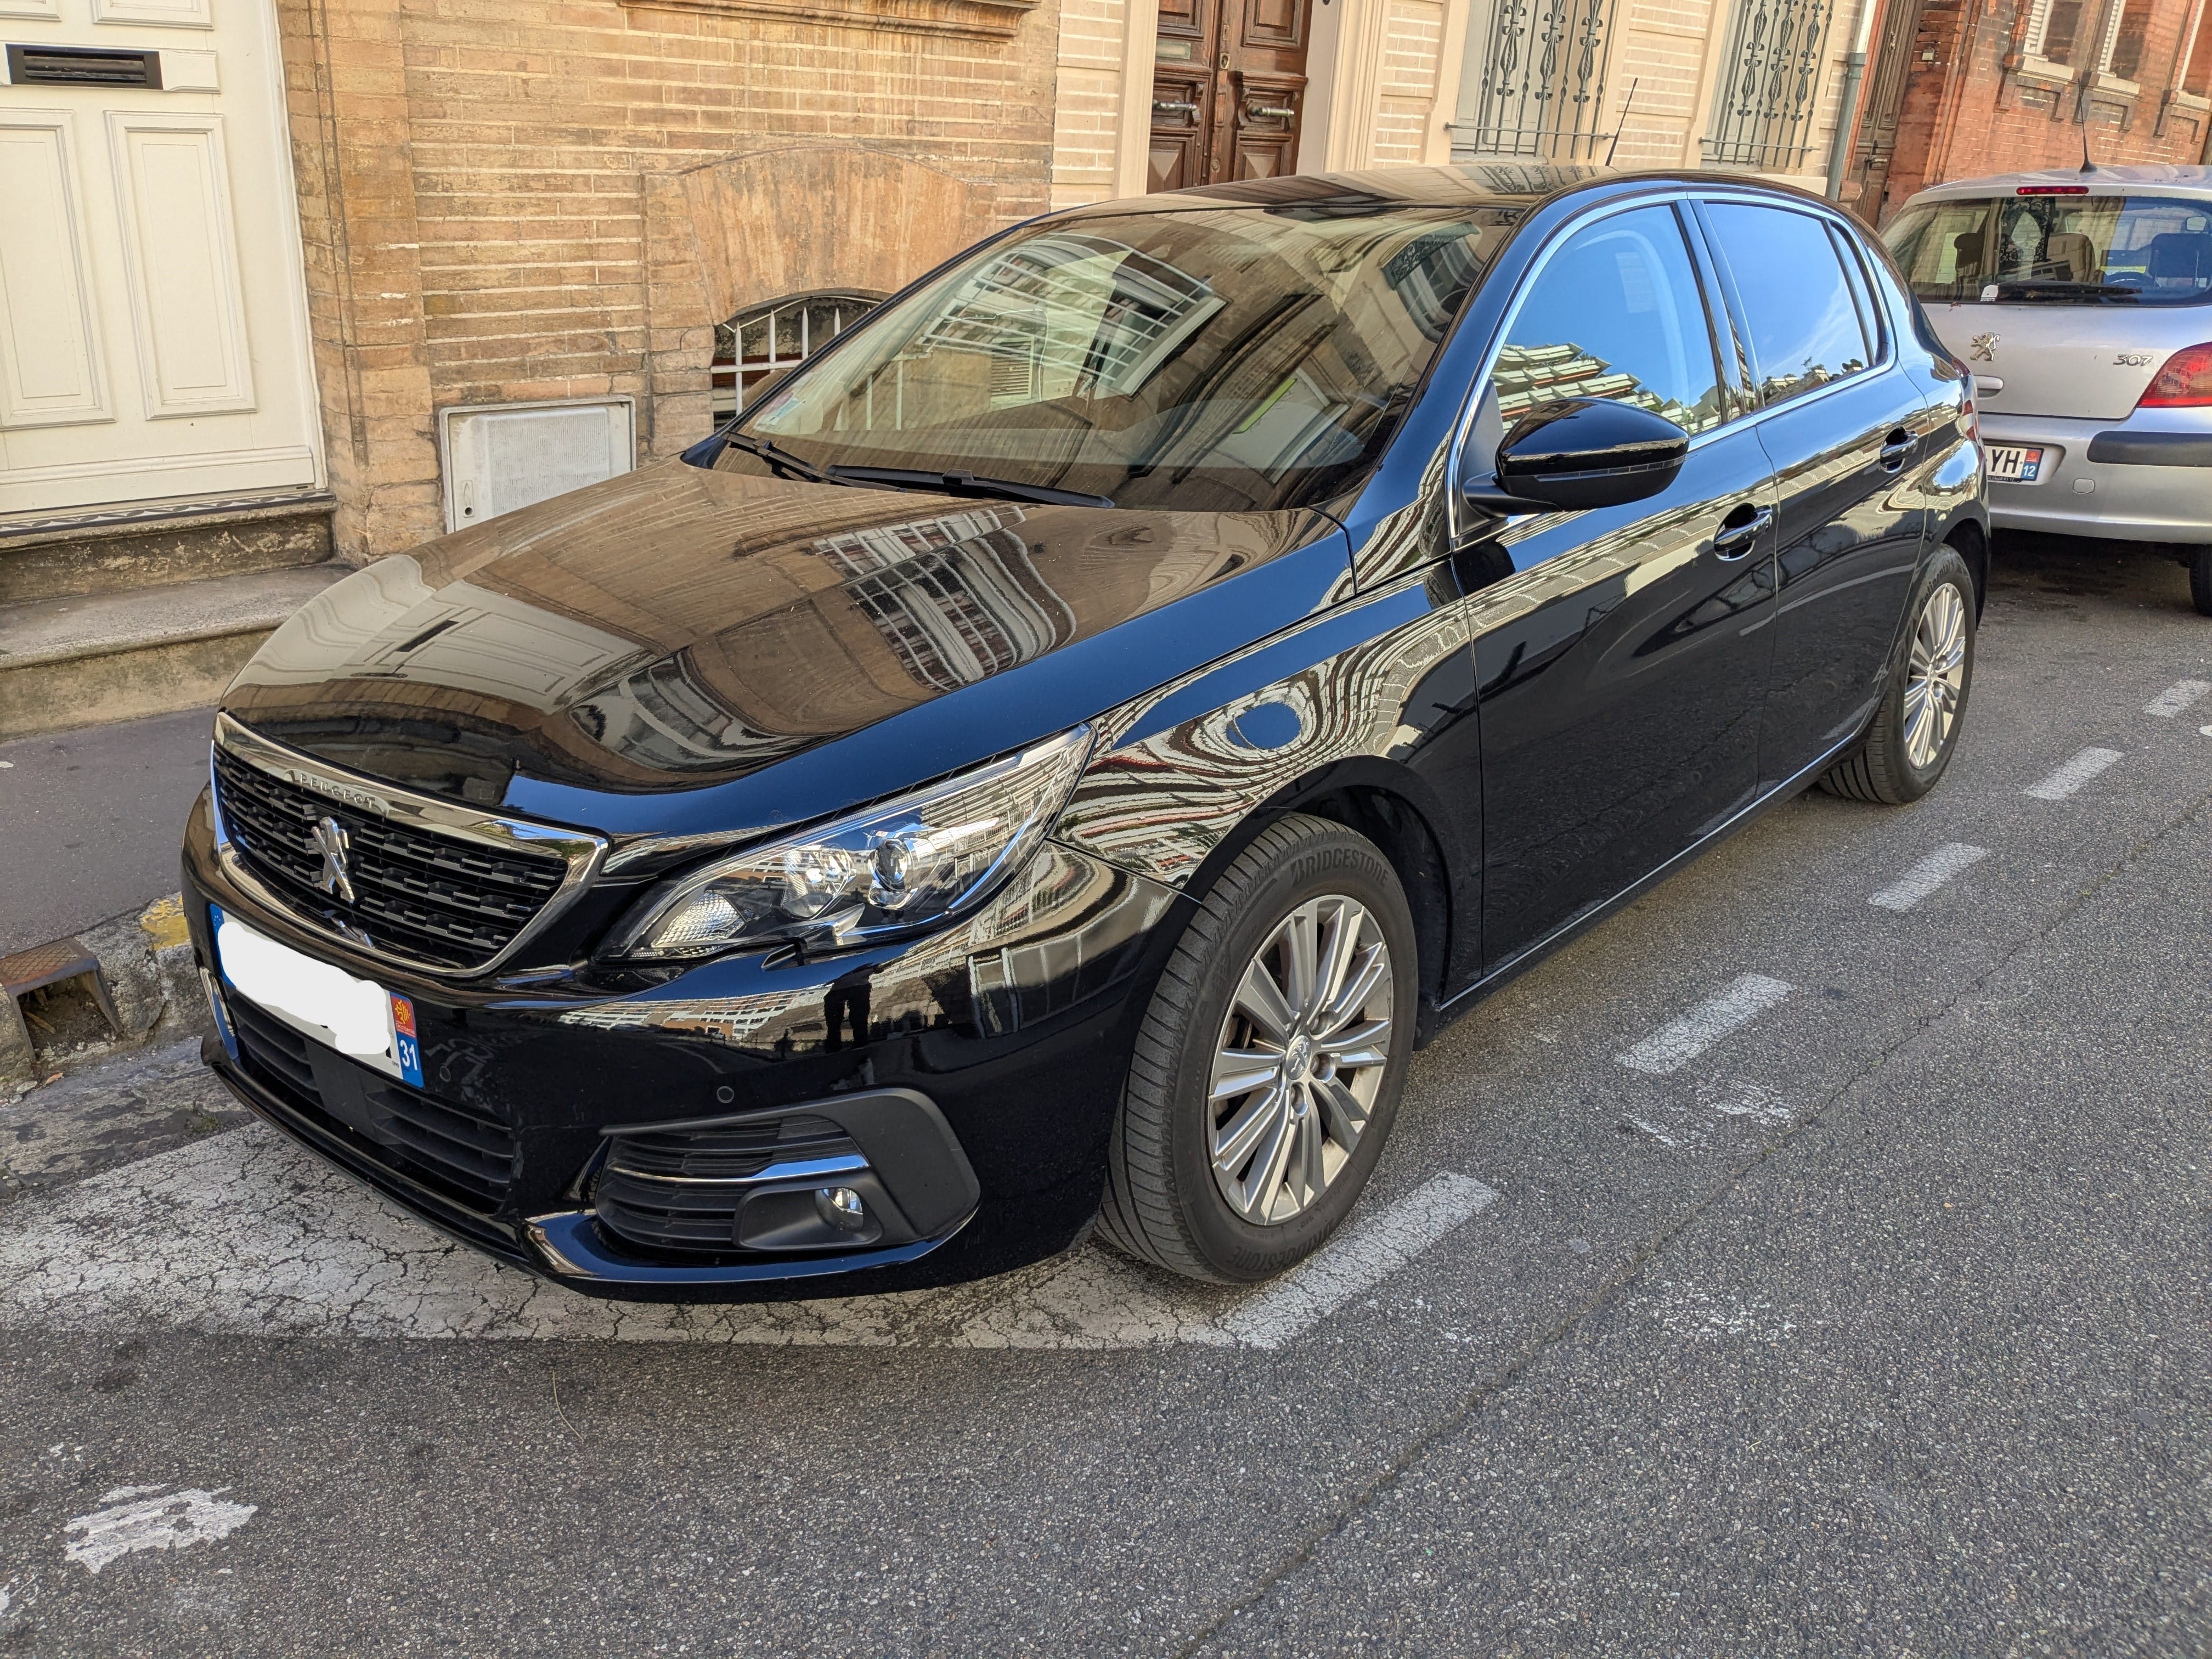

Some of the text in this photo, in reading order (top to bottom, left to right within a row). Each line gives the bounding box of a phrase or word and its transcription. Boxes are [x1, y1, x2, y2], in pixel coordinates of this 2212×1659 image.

[2113, 354, 2153, 366] 307
[2023, 465, 2036, 477] 12
[300, 773, 375, 809] PEUGEOT
[1290, 848, 1389, 888] BRIDGESTONE
[400, 1040, 418, 1071] 31
